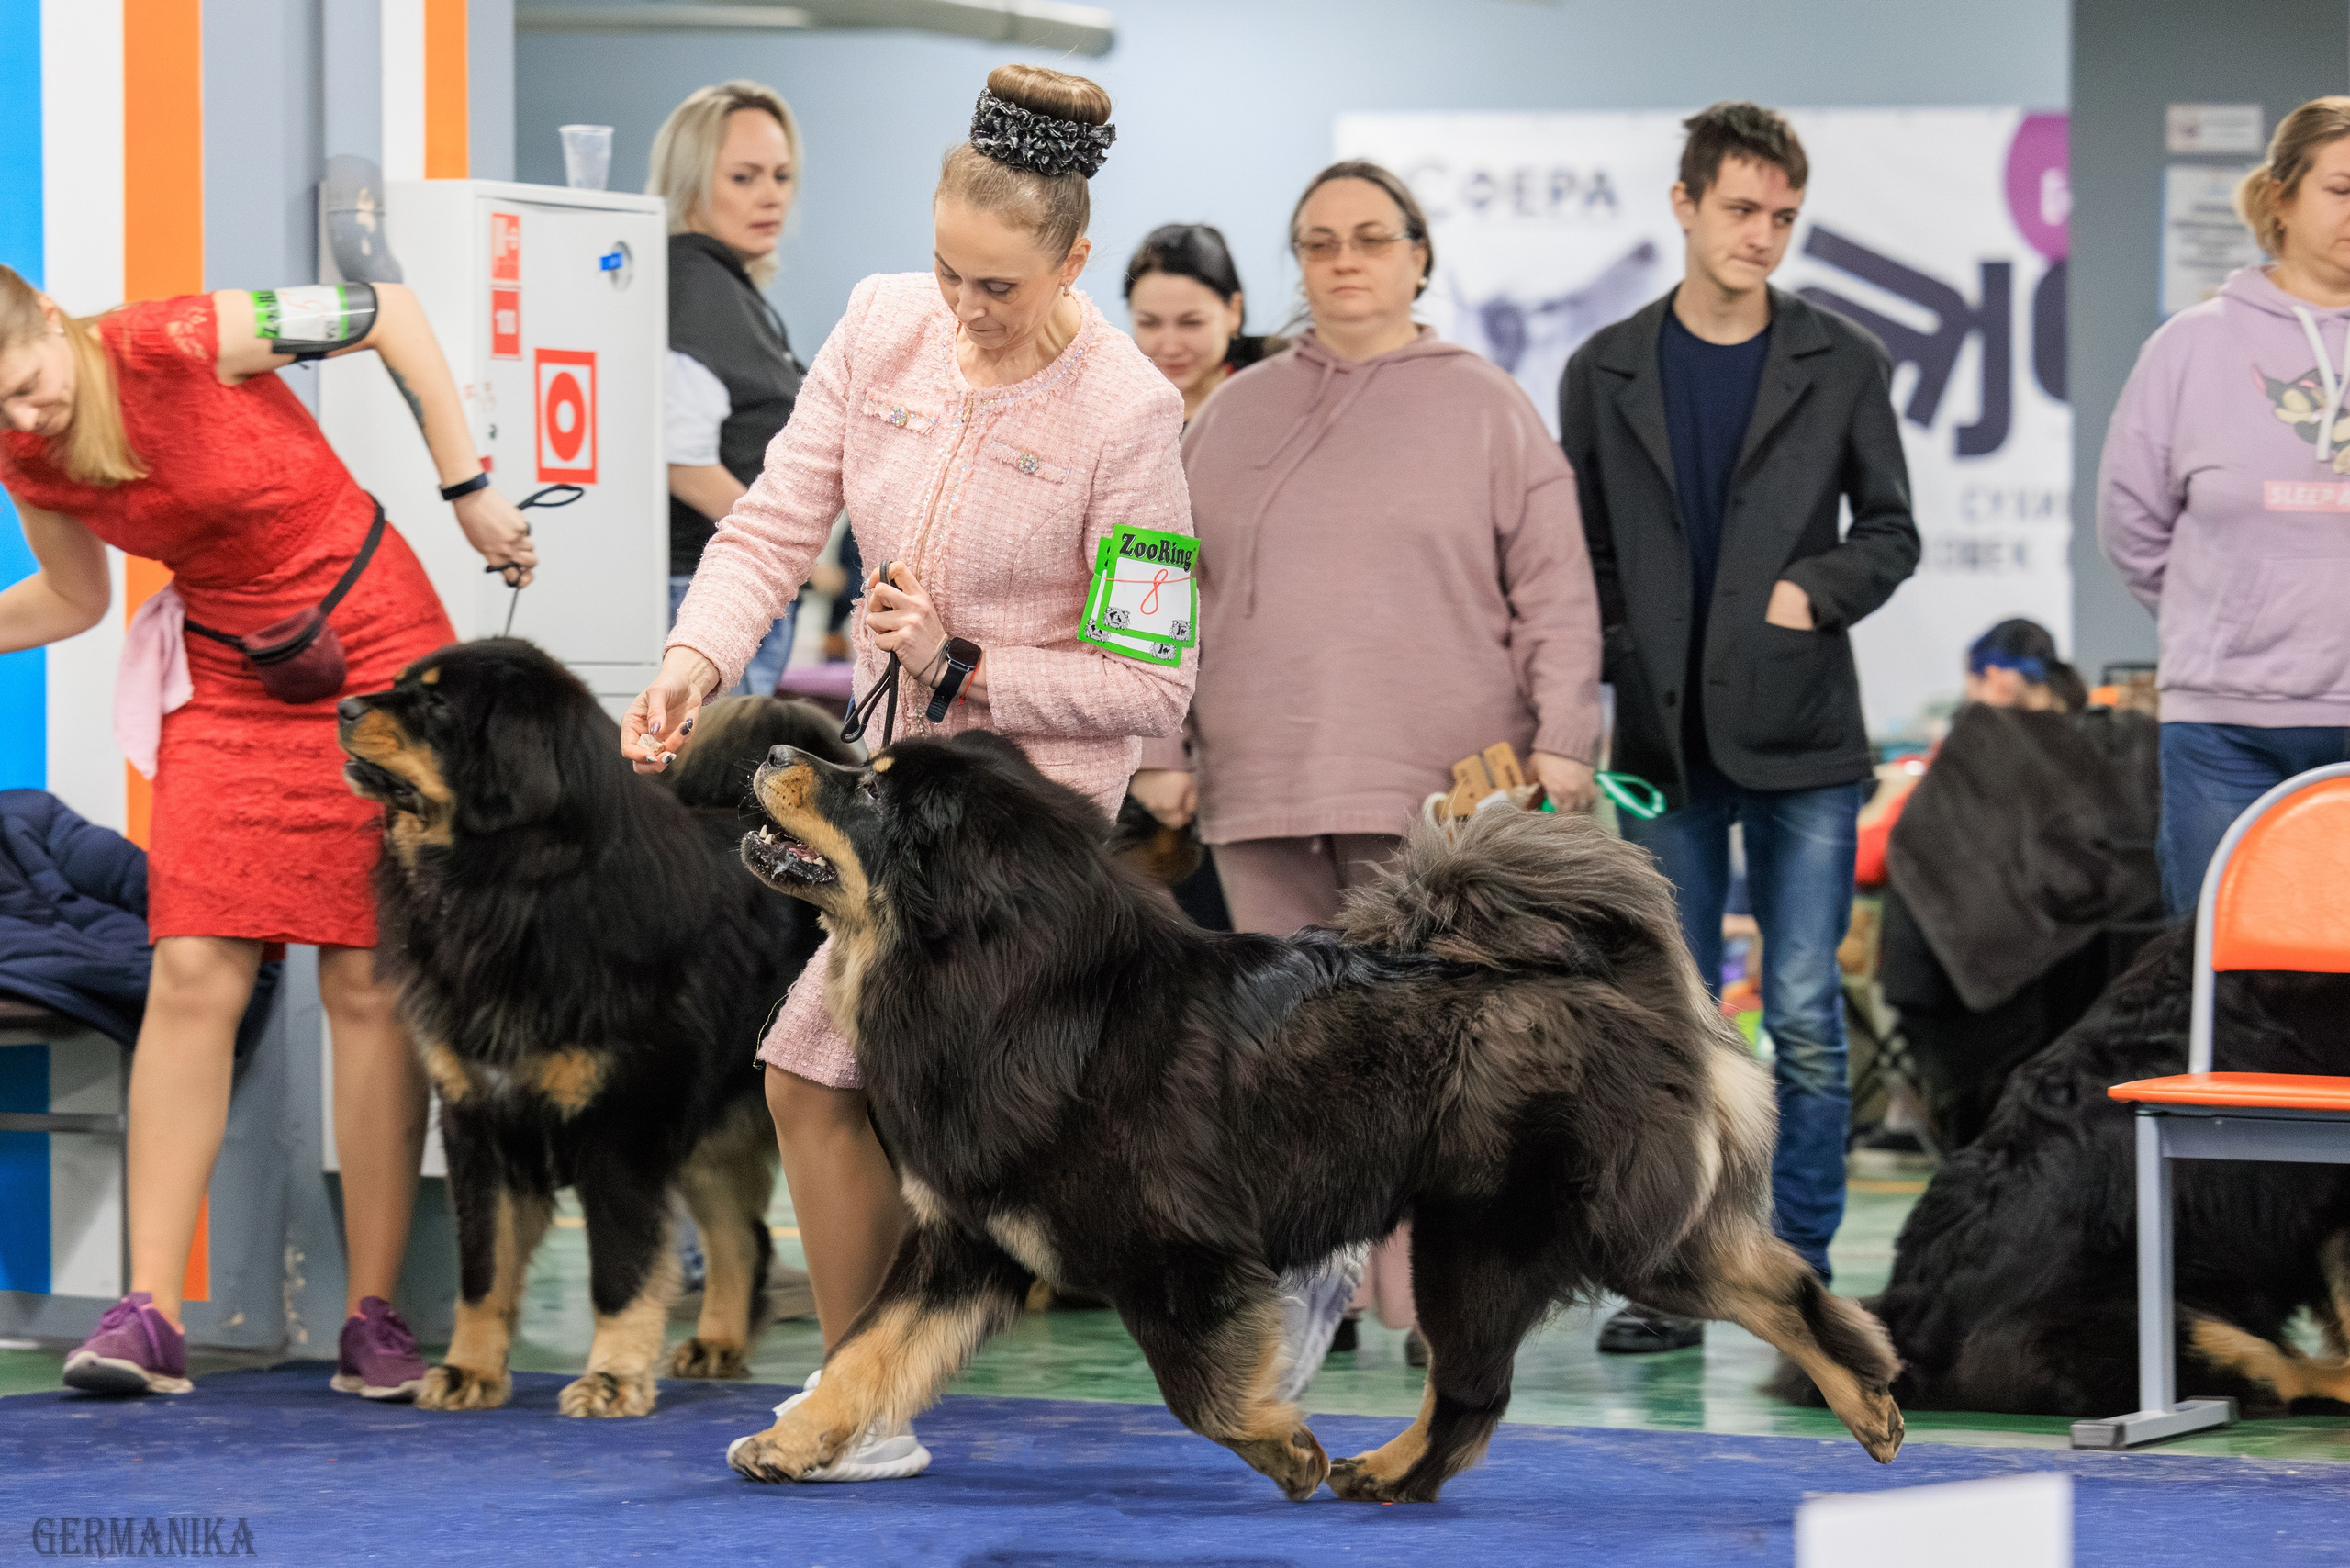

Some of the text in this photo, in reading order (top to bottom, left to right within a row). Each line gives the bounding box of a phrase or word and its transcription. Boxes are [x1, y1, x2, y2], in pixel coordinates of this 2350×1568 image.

[2269, 486, 2334, 506] SLEEP
[1120, 532, 1193, 573] ZooRing
[1140, 568, 1169, 615] 8
